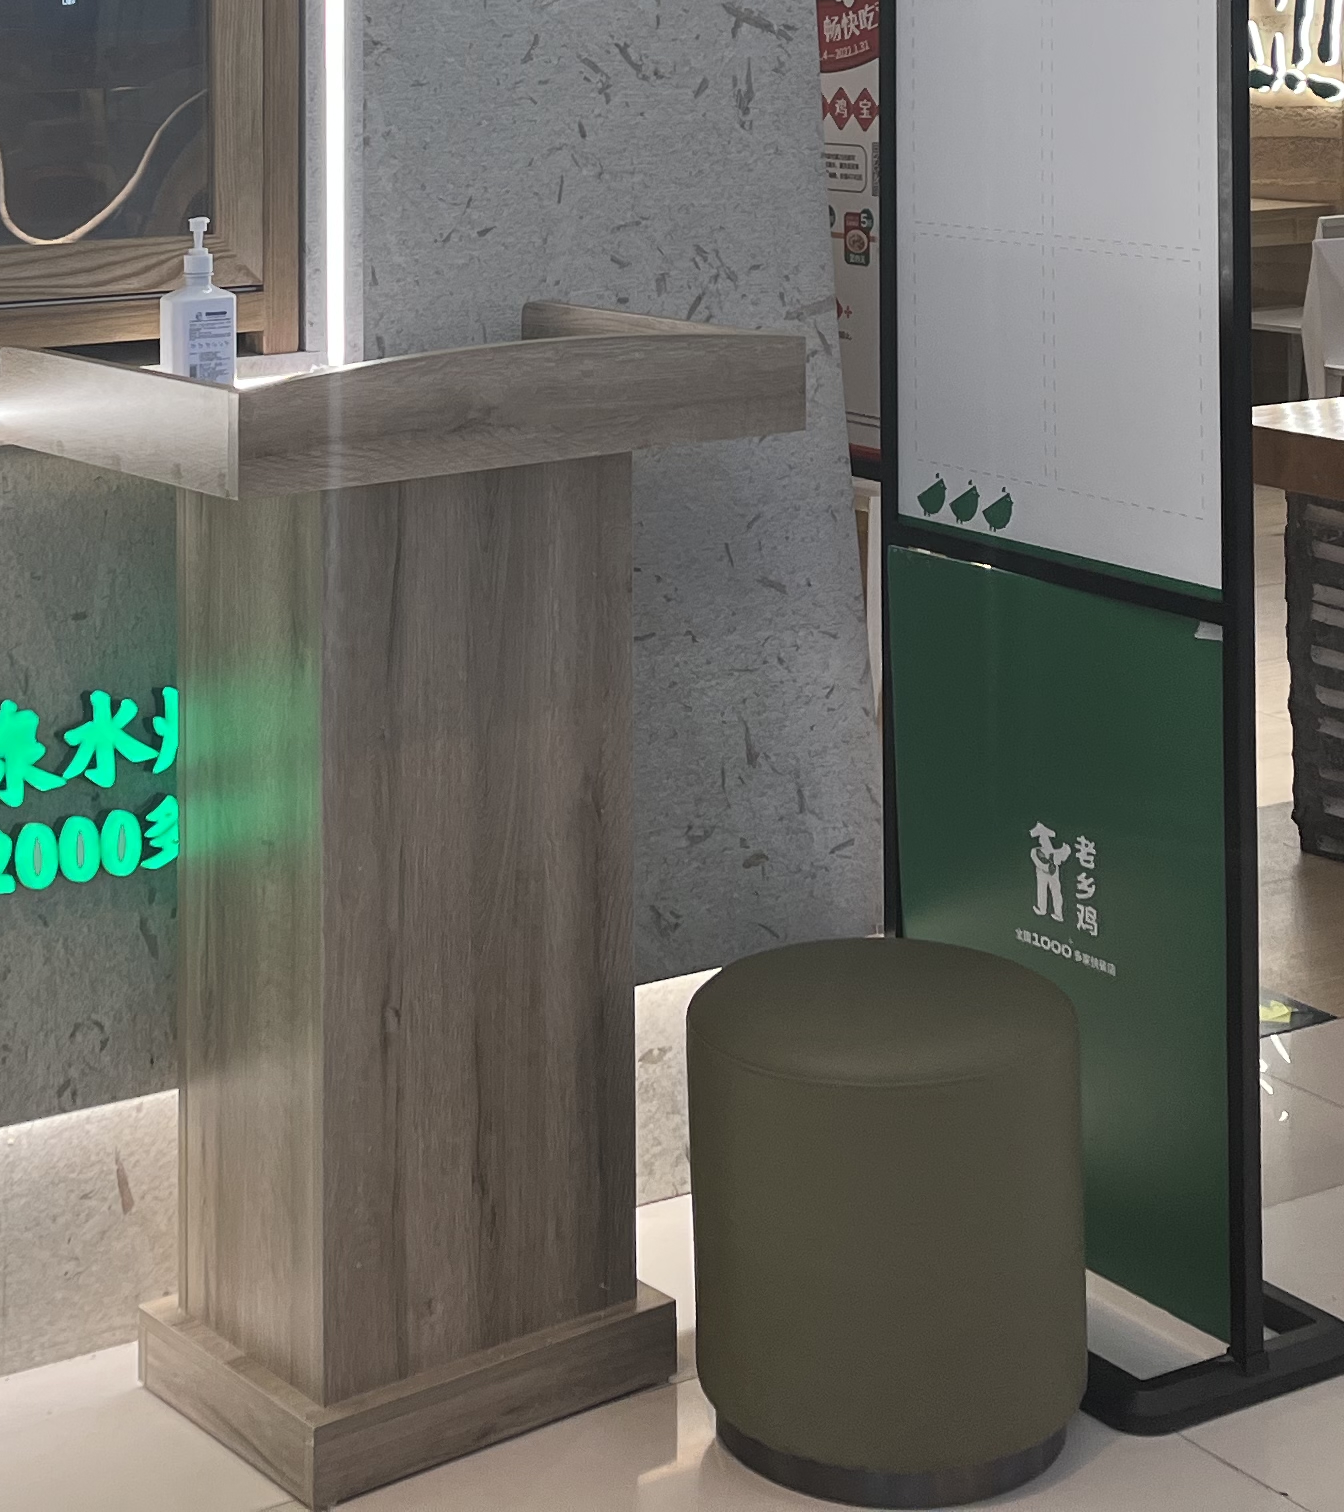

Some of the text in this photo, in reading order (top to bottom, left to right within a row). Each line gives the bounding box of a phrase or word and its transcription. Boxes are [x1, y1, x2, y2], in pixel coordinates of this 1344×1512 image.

[822, 1, 880, 42] 畅快吃
[1073, 834, 1098, 937] 老乡鸡
